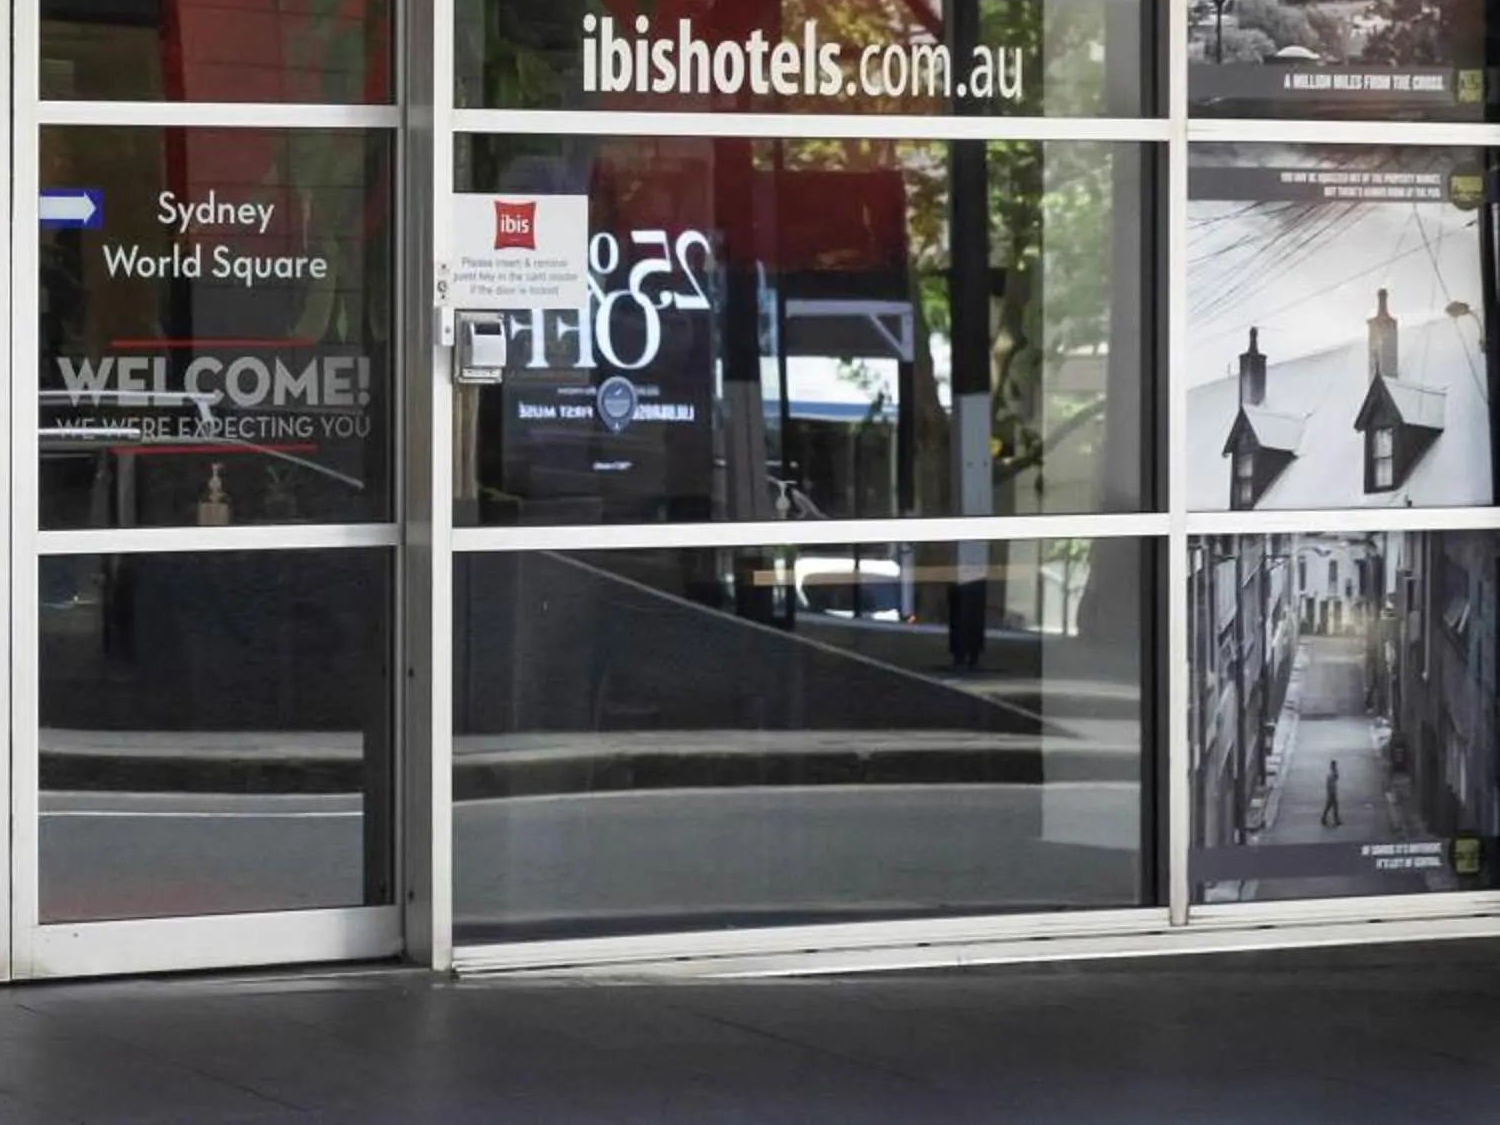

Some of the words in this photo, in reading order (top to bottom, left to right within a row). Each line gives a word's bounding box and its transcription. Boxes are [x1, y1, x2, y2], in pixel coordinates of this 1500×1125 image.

[582, 13, 1023, 99] ibishotels.com.au
[157, 189, 275, 233] Sydney
[500, 214, 530, 233] ibis
[102, 243, 201, 277] World
[212, 245, 328, 287] Square
[56, 356, 371, 408] WELCOME!
[101, 417, 173, 439] WERE
[179, 416, 314, 439] EXPECTING
[320, 416, 371, 438] YOU
